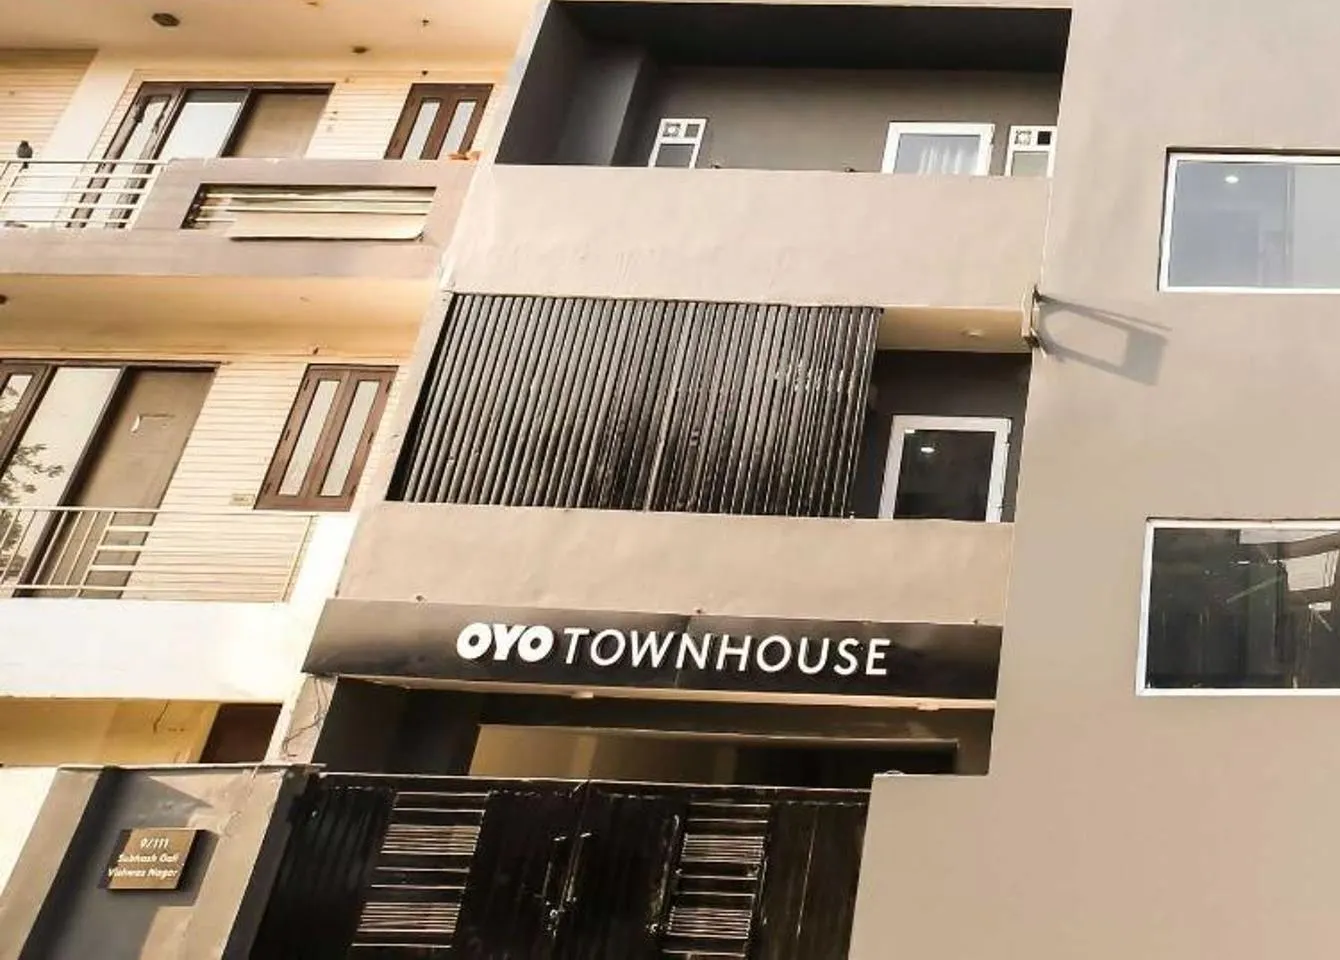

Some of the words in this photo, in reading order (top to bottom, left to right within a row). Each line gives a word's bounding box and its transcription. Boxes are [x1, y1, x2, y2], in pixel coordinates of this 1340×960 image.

[456, 622, 554, 662] OYO
[563, 627, 890, 675] TOWNHOUSE
[147, 868, 178, 880] Nagar
